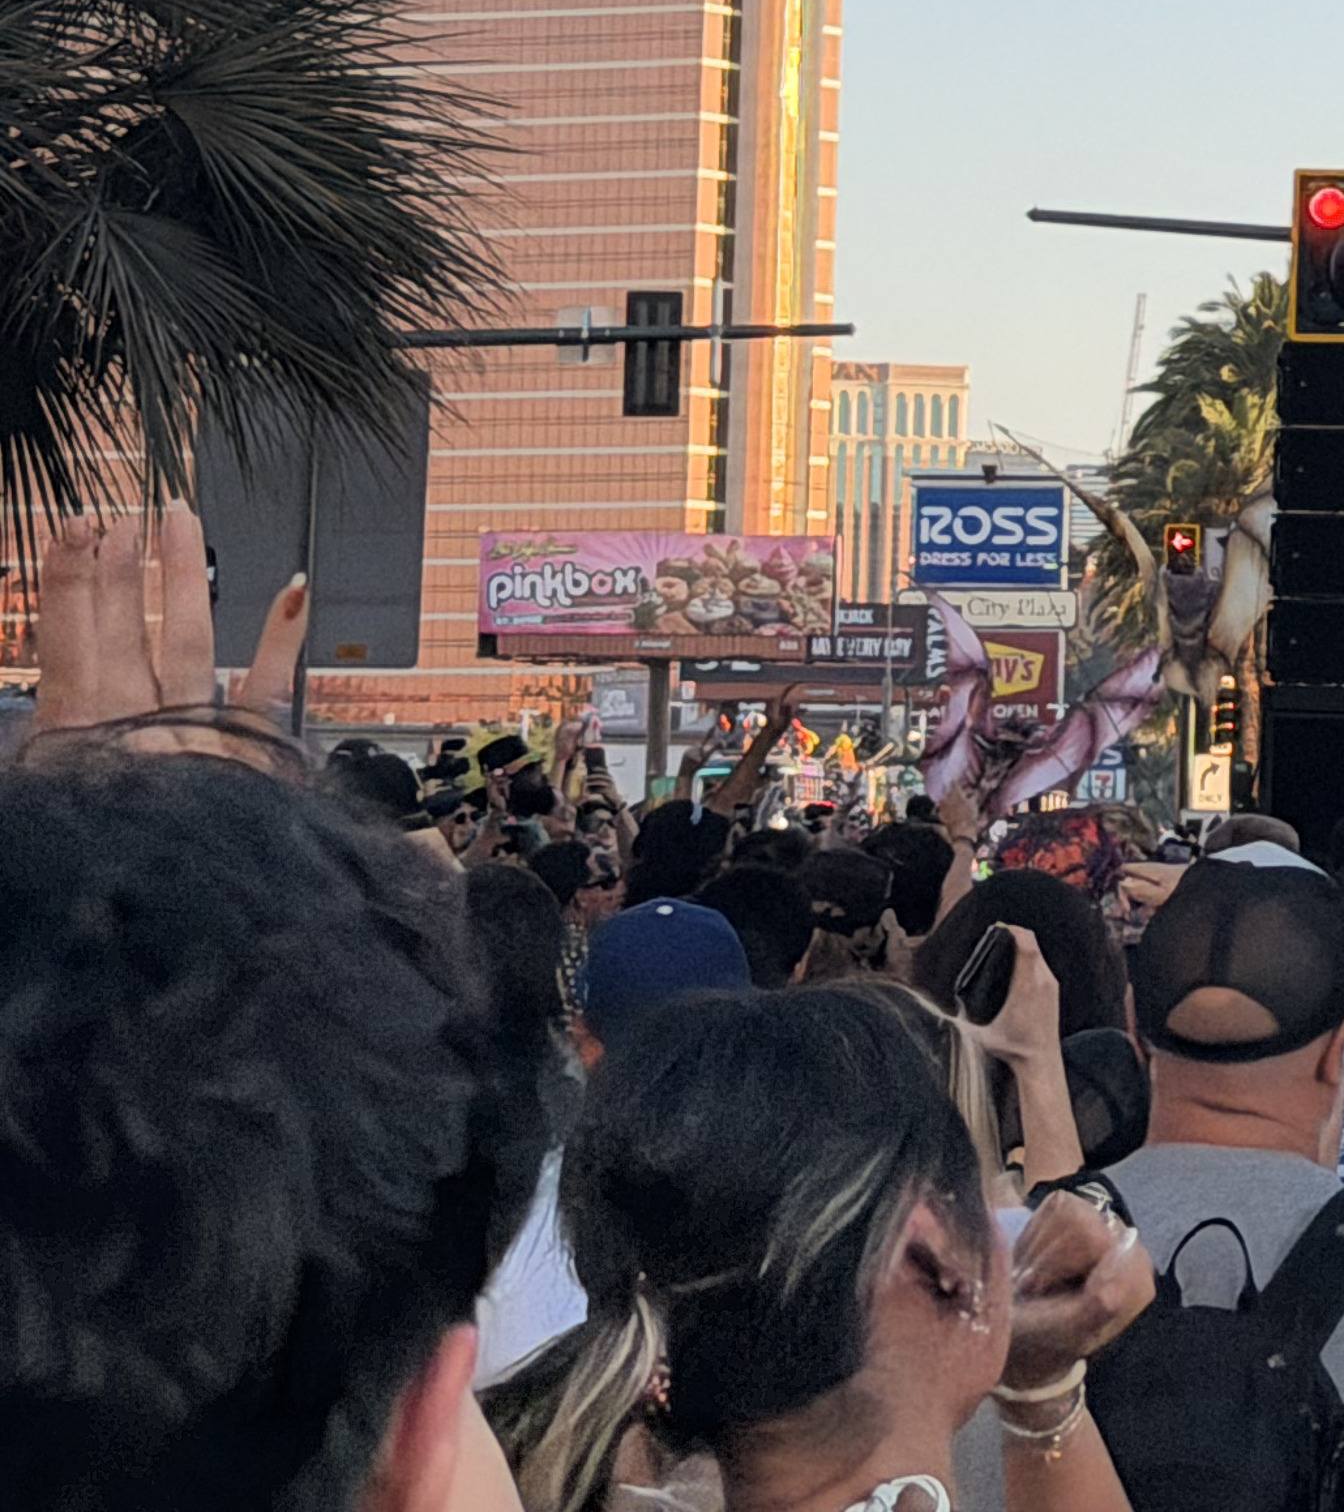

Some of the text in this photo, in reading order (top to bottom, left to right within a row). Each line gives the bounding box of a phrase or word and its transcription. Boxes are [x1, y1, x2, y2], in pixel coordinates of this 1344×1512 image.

[920, 506, 1059, 545] ROSS
[919, 551, 1058, 569] DRESS FOR LESS
[486, 562, 640, 609] pinkbox
[966, 597, 1010, 619] City
[993, 704, 1038, 718] OPEN
